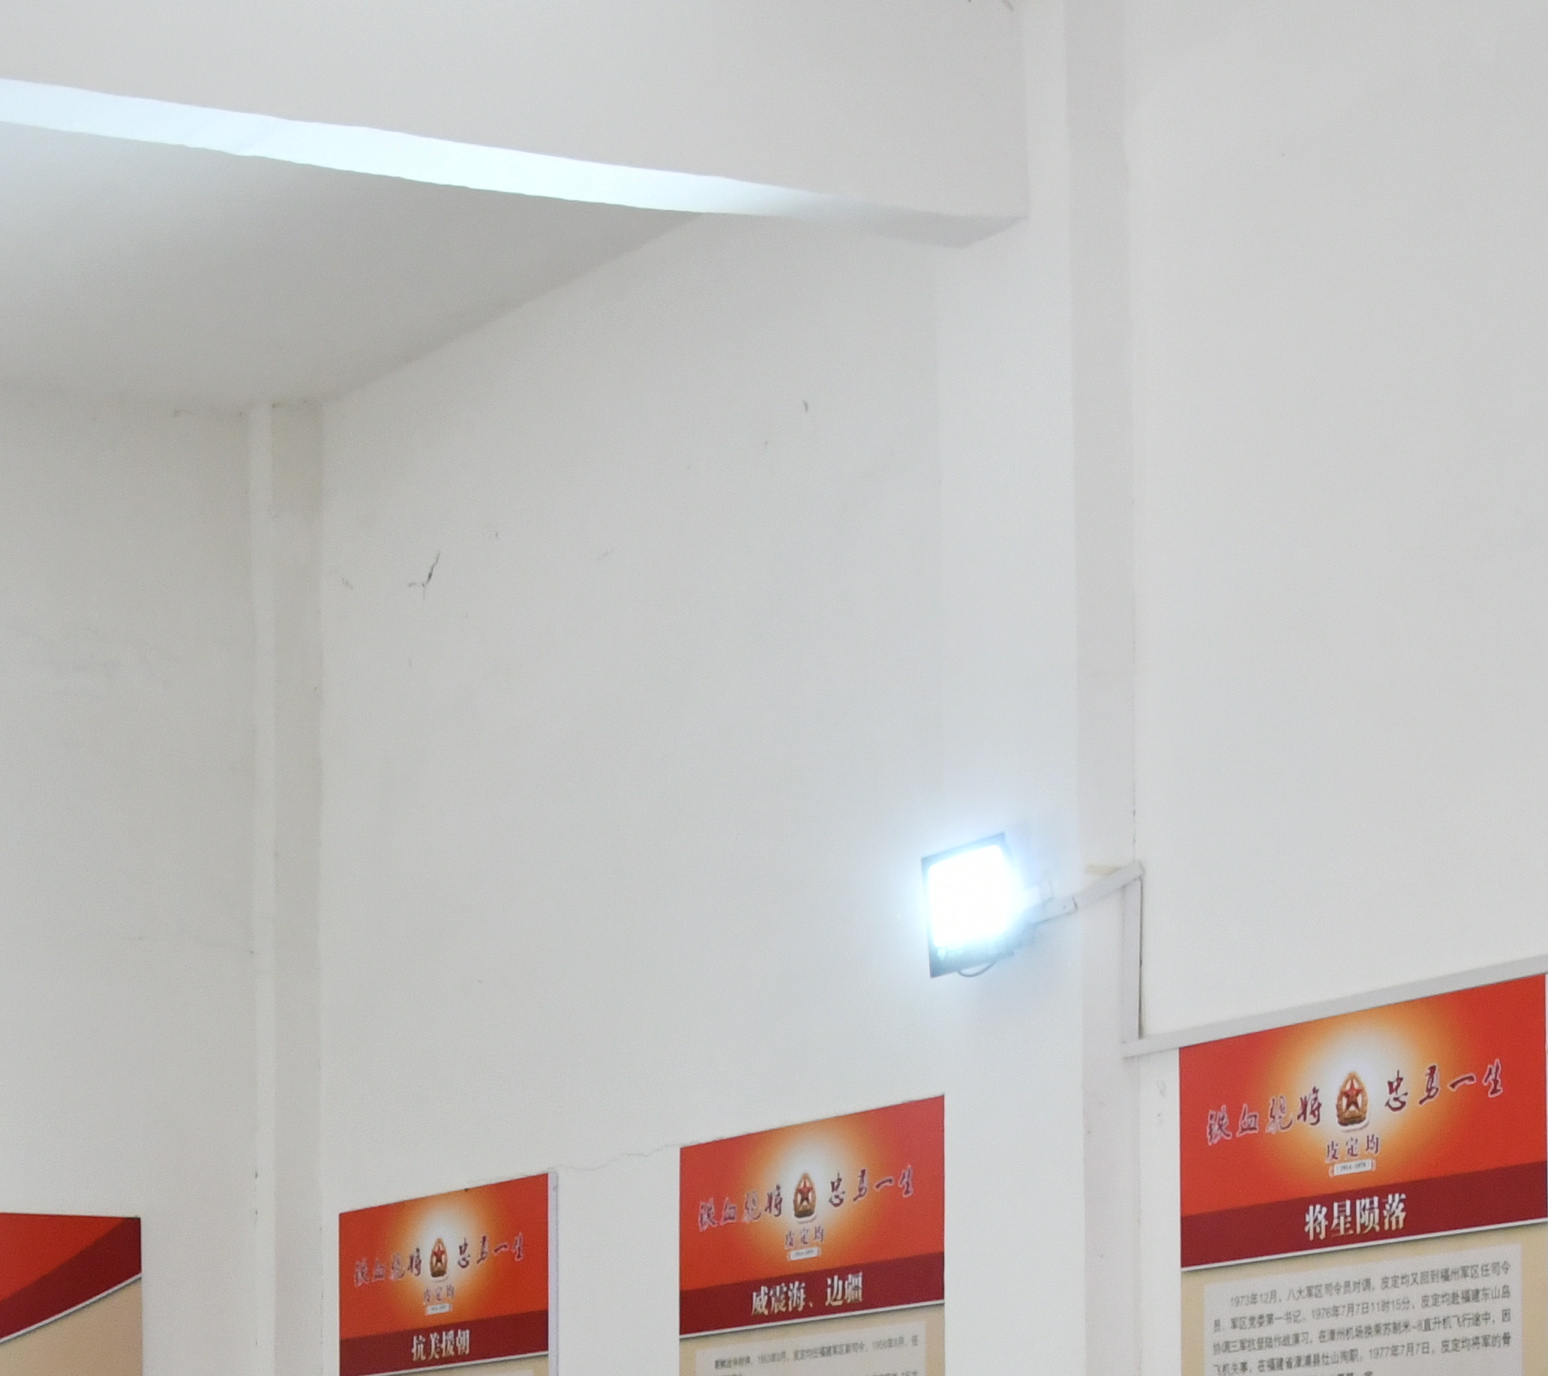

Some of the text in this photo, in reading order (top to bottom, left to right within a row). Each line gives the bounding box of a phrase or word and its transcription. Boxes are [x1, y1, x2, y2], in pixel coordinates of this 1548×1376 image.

[1206, 1051, 1503, 1145] 铁血骁将 忠勇一生
[1325, 1132, 1380, 1164] 皮定均
[1304, 1189, 1407, 1242] 将星陨落
[784, 1224, 824, 1250] 皮定均
[751, 1270, 863, 1318] 威震海、边疆
[410, 1326, 470, 1363] 抗美援朝
